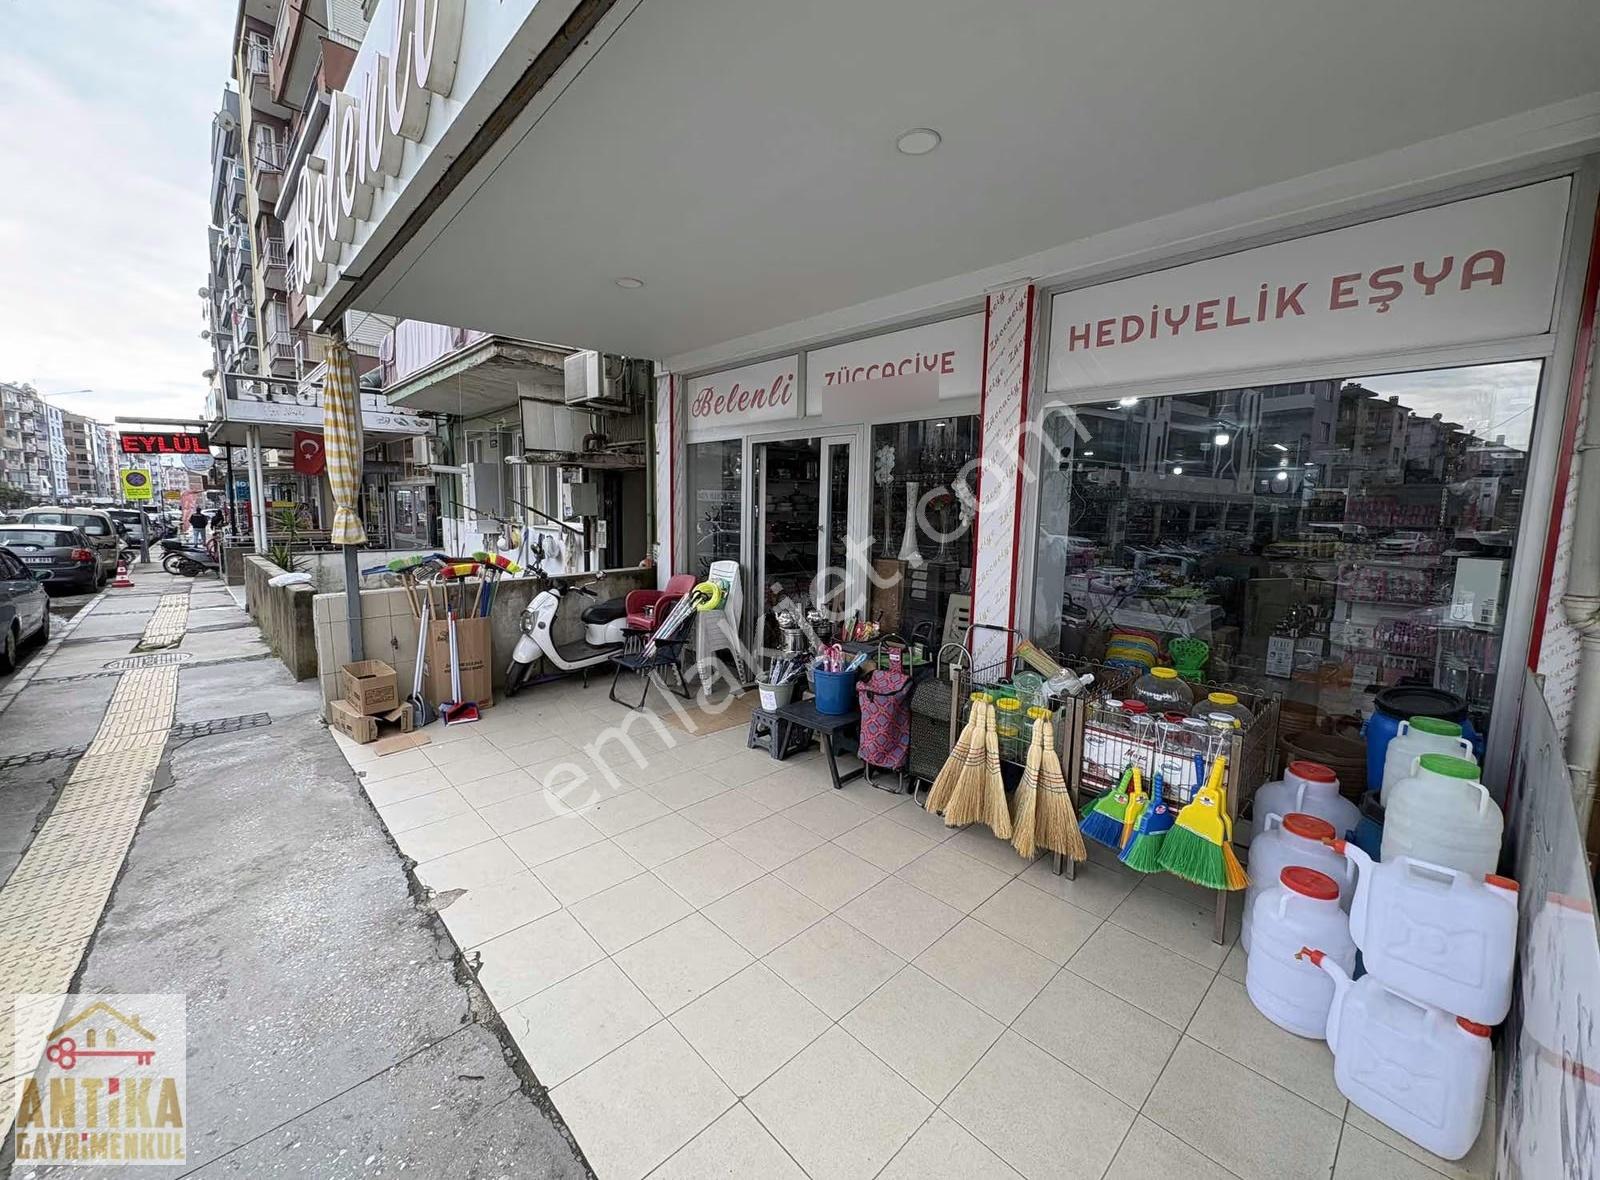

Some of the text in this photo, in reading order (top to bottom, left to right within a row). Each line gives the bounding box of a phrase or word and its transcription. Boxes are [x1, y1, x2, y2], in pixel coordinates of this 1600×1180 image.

[1068, 283, 1308, 352] HEDİYELİK
[1328, 249, 1506, 313] EŞYA
[691, 373, 794, 418] Belenli
[121, 431, 209, 453] EYLÜL
